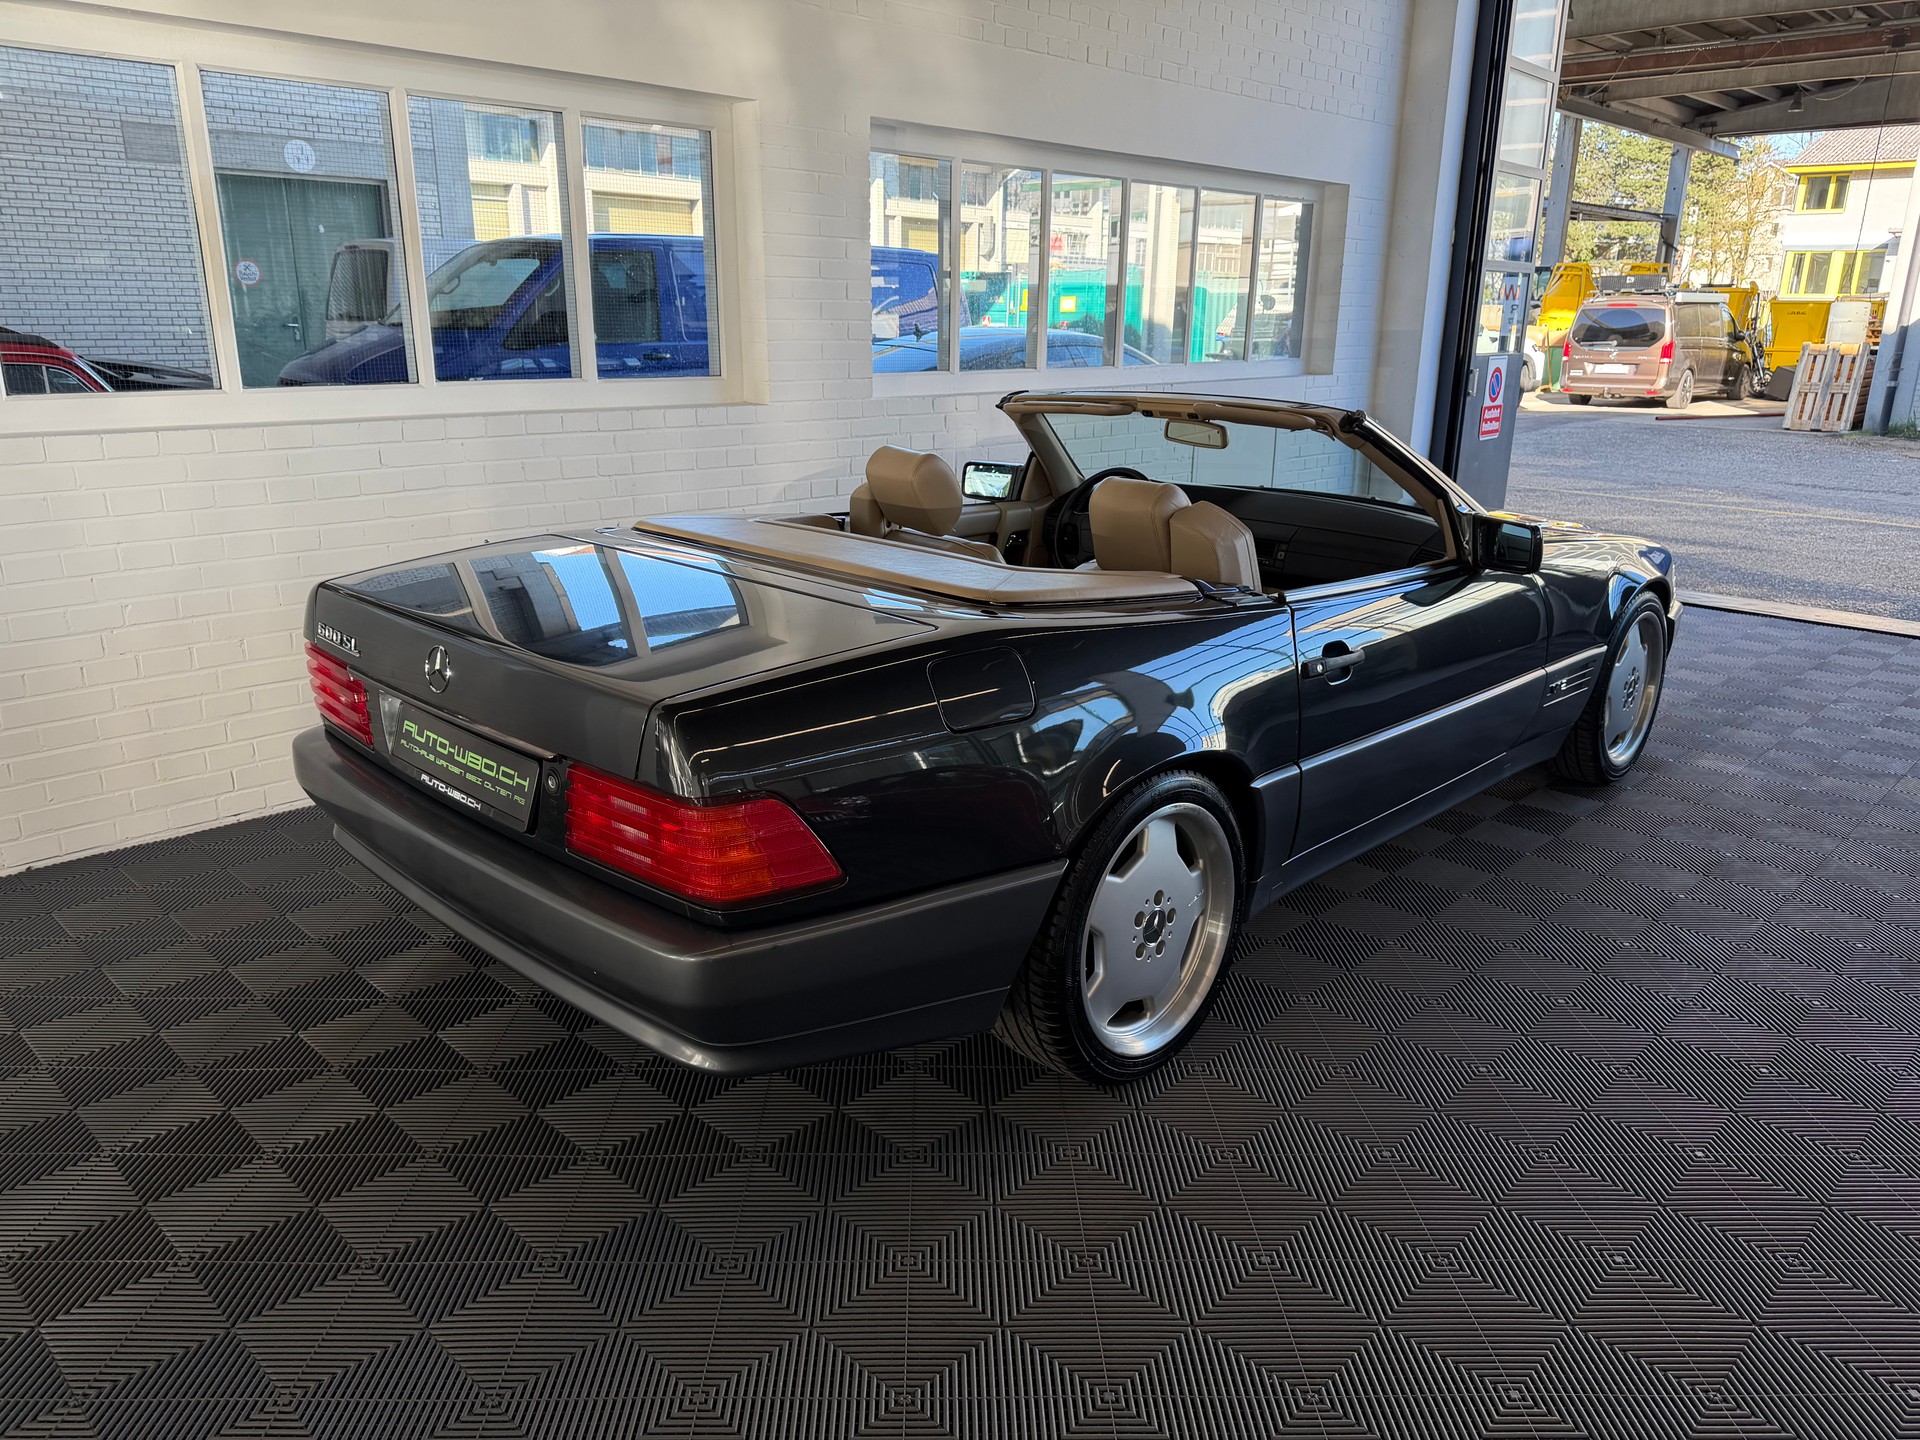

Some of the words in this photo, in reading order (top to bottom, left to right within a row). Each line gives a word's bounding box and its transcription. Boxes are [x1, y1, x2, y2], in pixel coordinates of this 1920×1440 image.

[317, 621, 342, 646] 600
[342, 634, 360, 653] SL
[402, 720, 530, 792] AUTO-WBO.CH
[465, 772, 483, 785] BEI
[483, 780, 512, 799] OLTEN
[513, 794, 526, 806] AG
